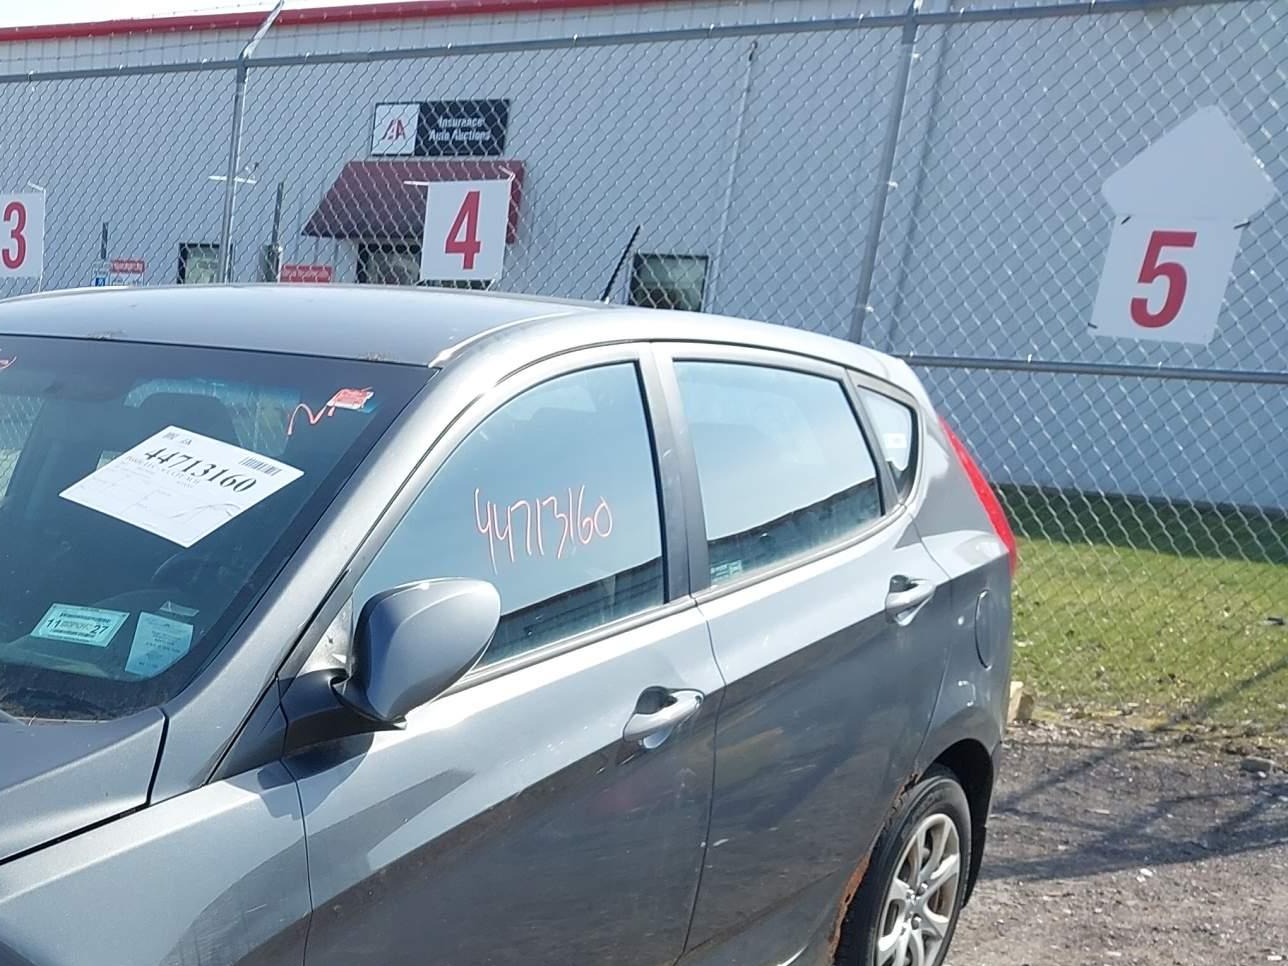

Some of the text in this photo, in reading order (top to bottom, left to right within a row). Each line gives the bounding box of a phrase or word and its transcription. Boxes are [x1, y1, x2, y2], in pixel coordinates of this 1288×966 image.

[428, 129, 492, 141] Auto Auctions
[438, 116, 484, 128] Insurance
[0, 201, 27, 269] 3
[445, 190, 482, 270] 4
[1130, 230, 1197, 328] 5
[144, 447, 257, 493] 44713160
[474, 484, 613, 575] 44713160
[47, 618, 60, 629] 11
[90, 624, 109, 635] 27
